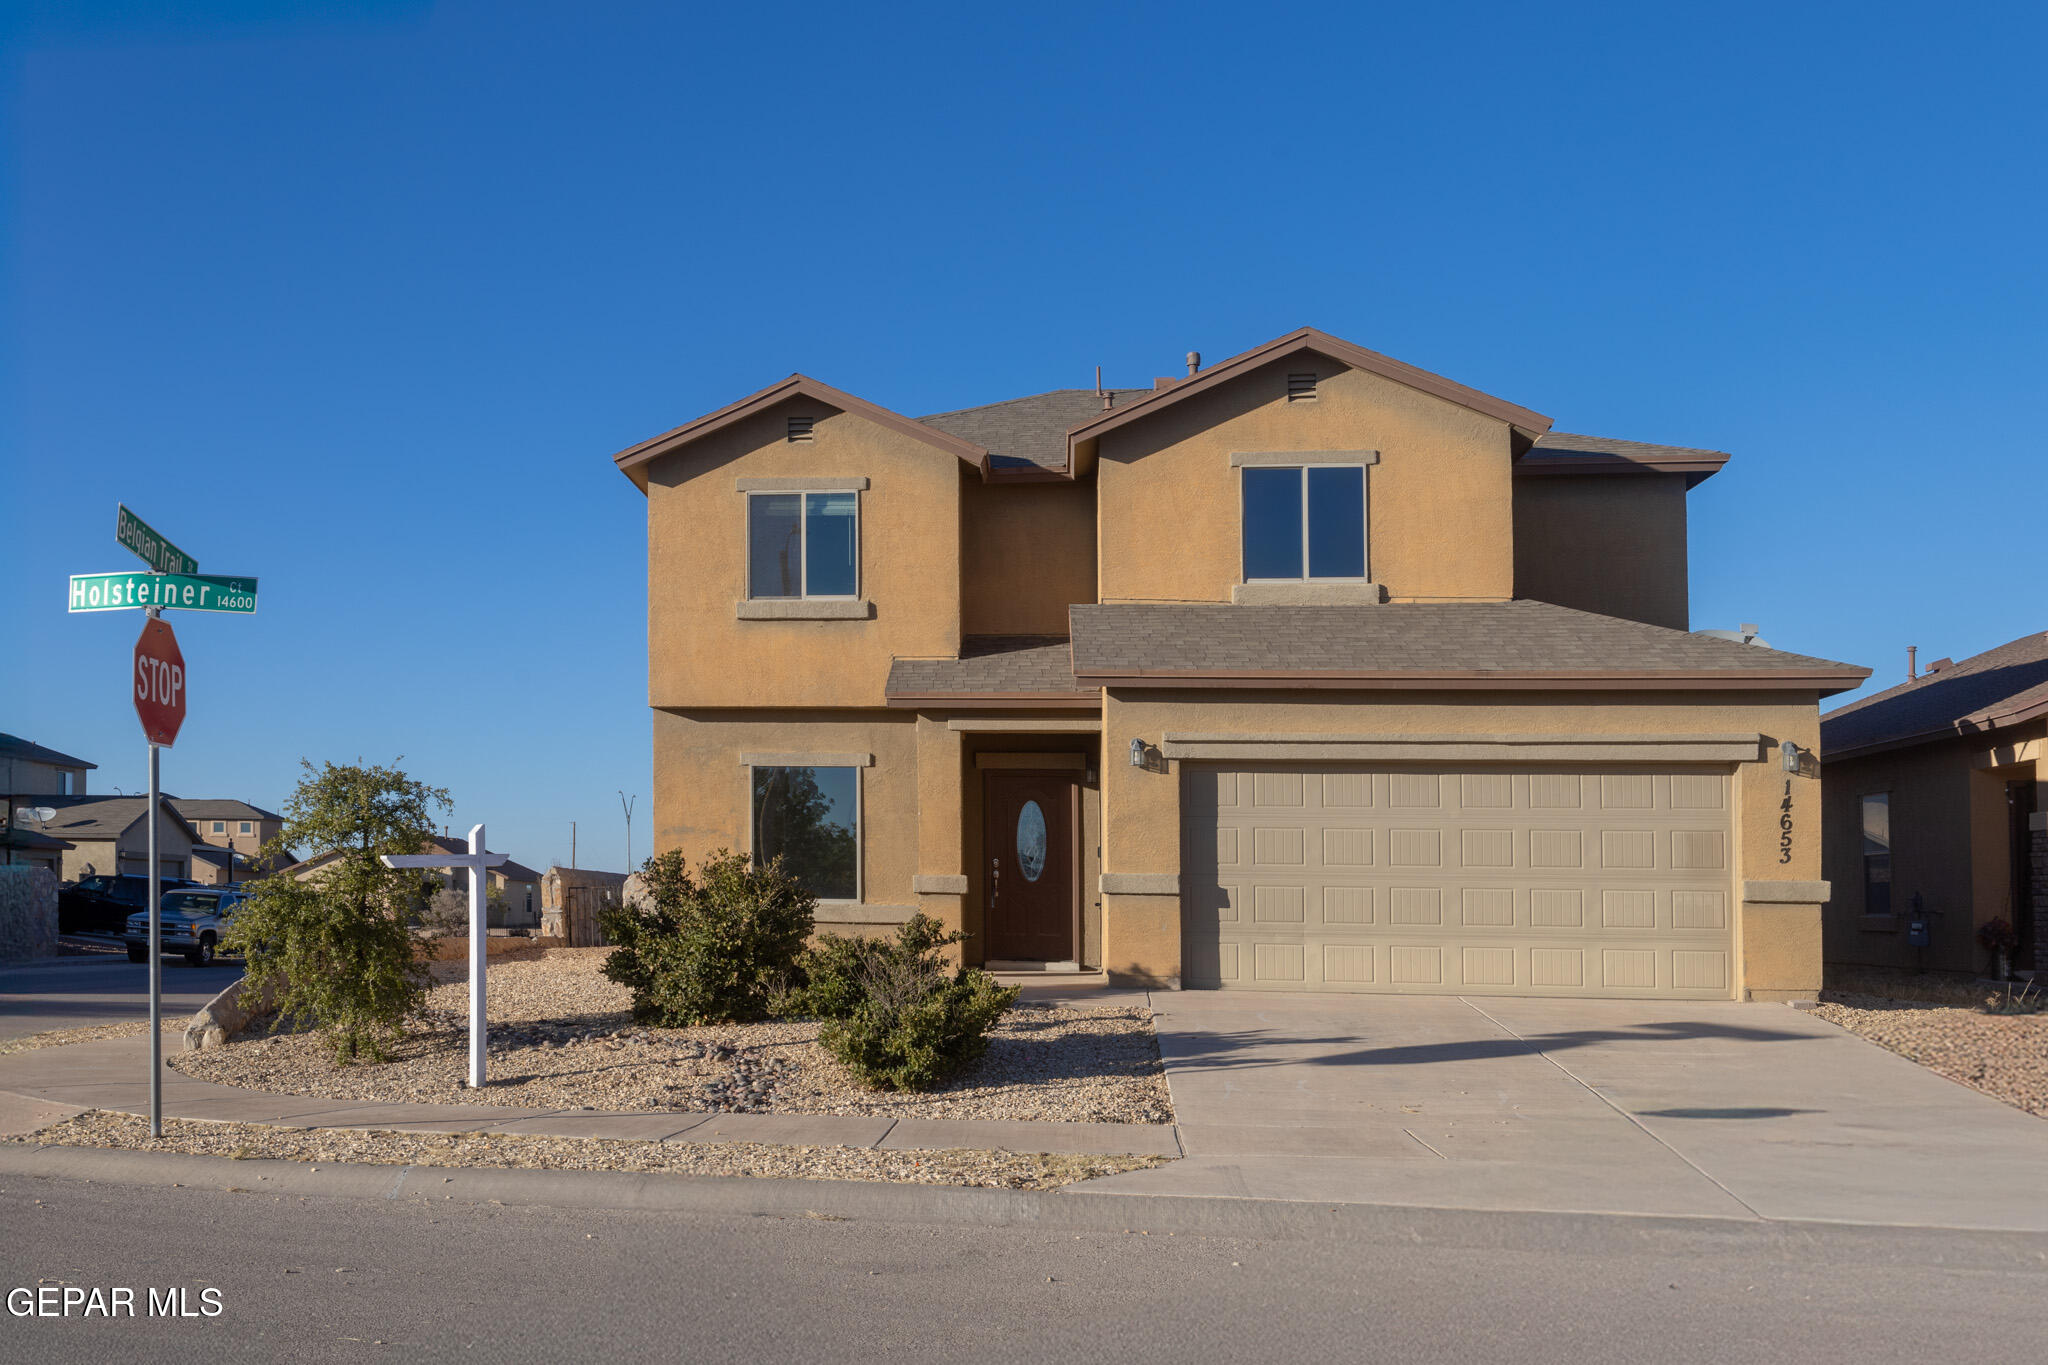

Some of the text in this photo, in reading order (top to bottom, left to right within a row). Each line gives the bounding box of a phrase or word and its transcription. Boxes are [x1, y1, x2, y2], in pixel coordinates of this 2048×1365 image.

[119, 509, 157, 564] Belgian
[160, 541, 183, 573] Trail
[72, 577, 210, 607] Holsteiner
[217, 595, 253, 609] 14600
[229, 581, 242, 593] Ct
[137, 654, 183, 707] STOP
[1779, 779, 1793, 864] 14653
